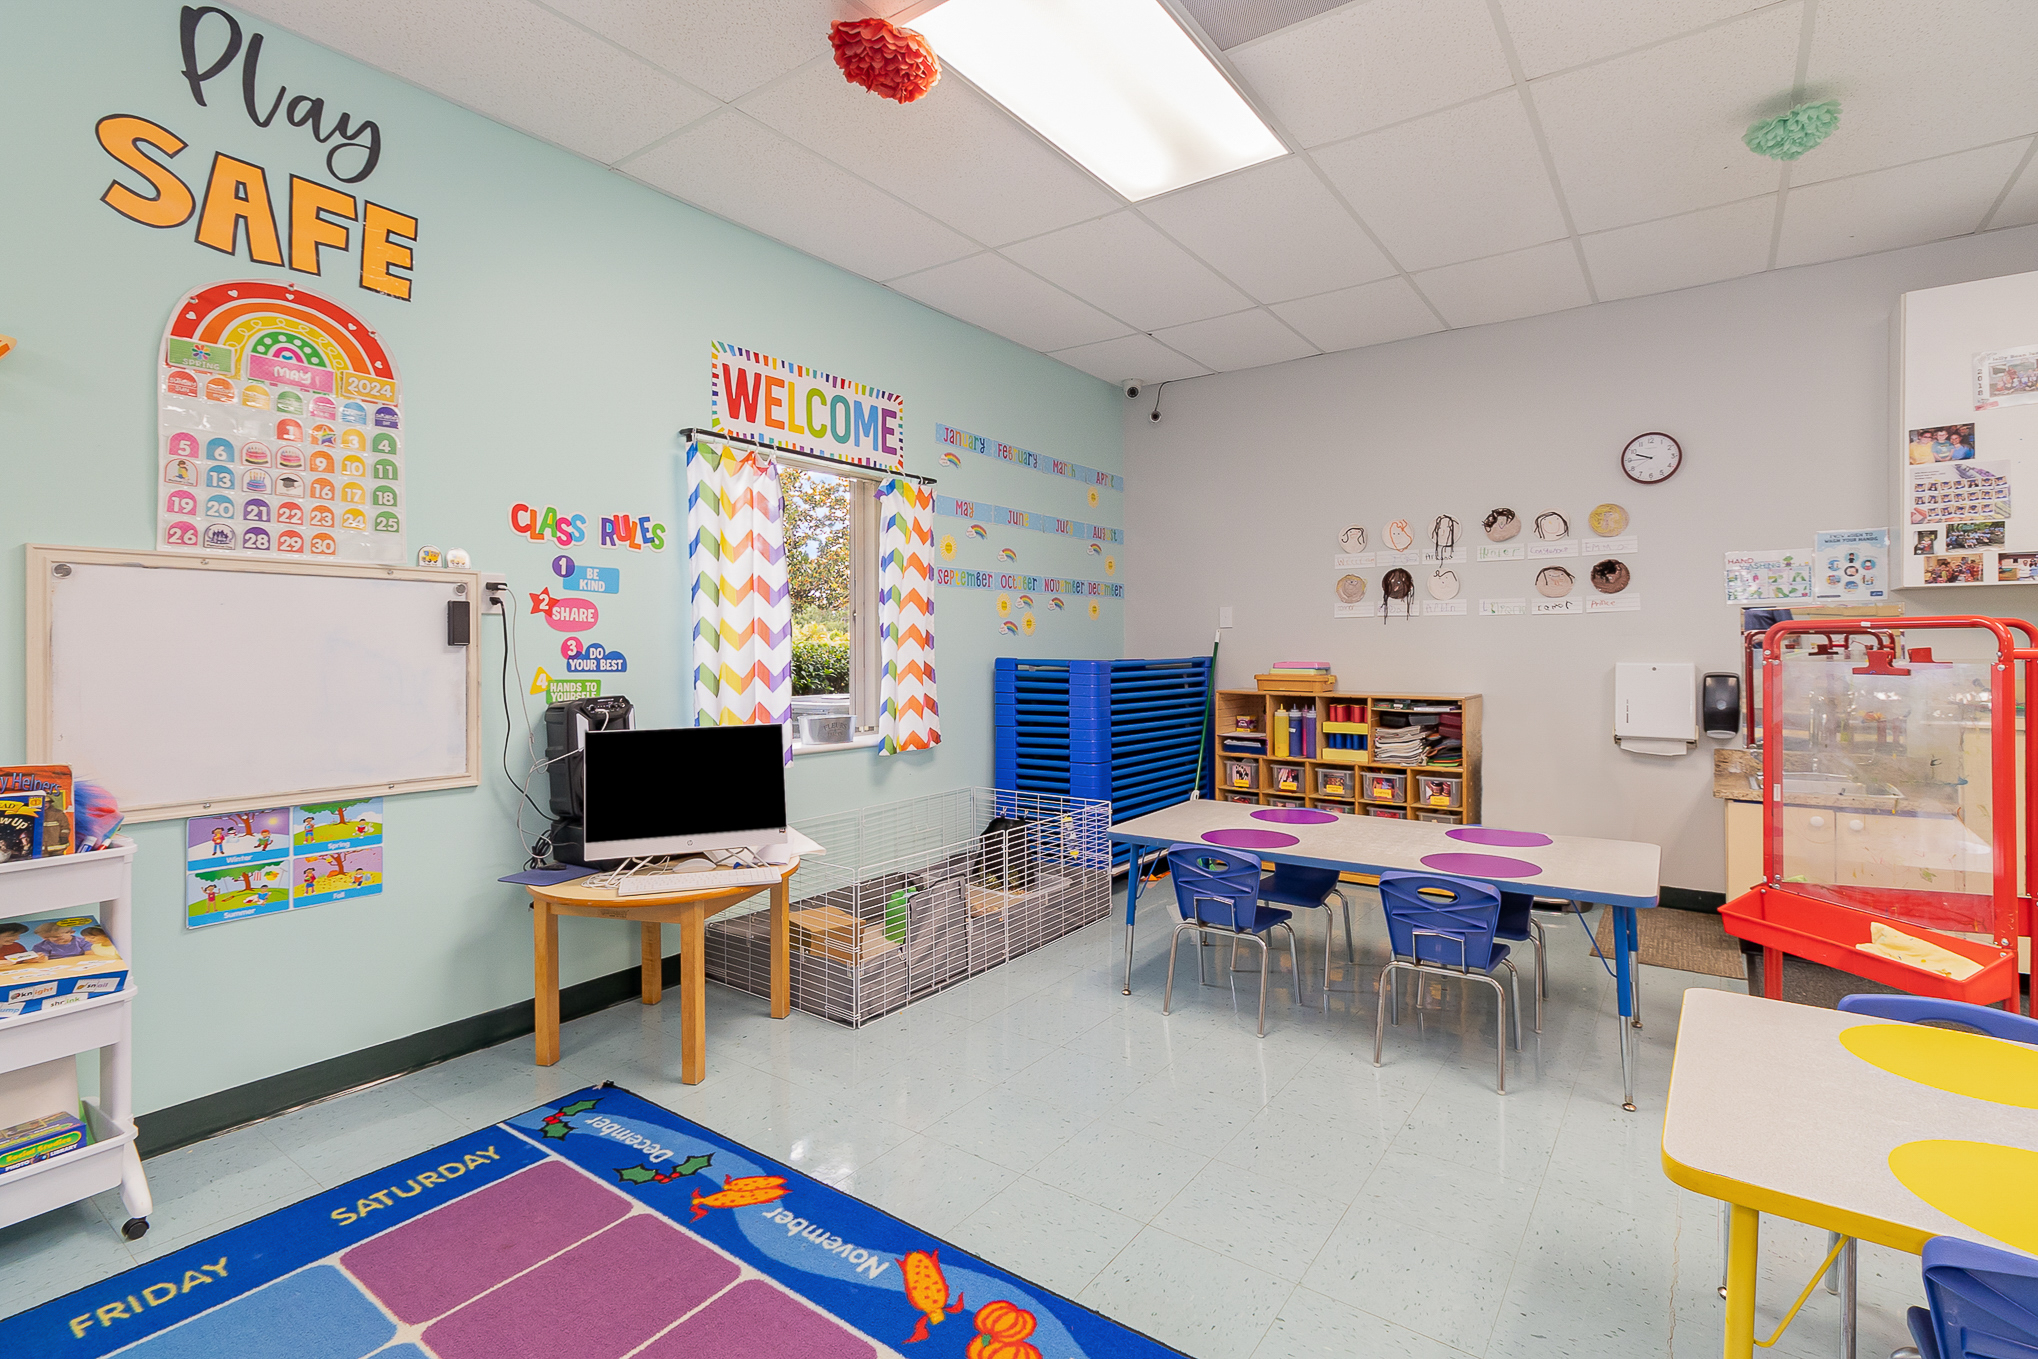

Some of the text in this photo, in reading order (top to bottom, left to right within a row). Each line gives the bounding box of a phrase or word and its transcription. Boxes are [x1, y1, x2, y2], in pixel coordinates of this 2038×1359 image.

[180, 5, 380, 183] Play
[95, 113, 418, 302] SAFE
[182, 358, 220, 371] SPRING
[274, 366, 312, 384] MAY
[348, 376, 393, 398] 2024
[721, 362, 897, 456] WELCOME
[178, 440, 226, 460] 5 6
[348, 436, 359, 448] 3
[378, 439, 392, 453] 4
[943, 427, 986, 454] January
[997, 443, 1038, 469] February
[1052, 459, 1076, 478] March
[317, 457, 394, 477] 9 10 11
[210, 472, 232, 487] 13
[314, 485, 332, 499] 16
[345, 488, 362, 502] 17
[377, 491, 394, 506] 18
[171, 497, 398, 532] 19 20 21 22 23 24 25
[955, 500, 1118, 542] May June July August
[511, 503, 666, 550] CLASS RULES
[168, 526, 335, 554] 26 28 29 30
[558, 557, 566, 576] 1
[1727, 557, 1754, 565] HAND
[586, 568, 600, 580] BE
[937, 569, 1123, 597] September October November December
[579, 579, 606, 592] KIND
[539, 594, 550, 610] 2
[552, 607, 595, 623] SHARE
[567, 640, 577, 656] 3
[589, 647, 604, 659] DO
[569, 659, 624, 671] YOUR BEST
[536, 673, 548, 689] 4
[550, 682, 598, 693] HANDS TO
[11, 817, 29, 830] Up
[327, 840, 351, 851] Spring
[226, 854, 254, 864] Winter
[332, 891, 345, 900] Fall
[223, 907, 256, 919] Summer
[20, 986, 54, 998] knight
[50, 997, 80, 1008] shrink
[584, 1116, 675, 1163] December
[4, 1143, 78, 1172] PHOTO LIBRARY
[331, 1145, 501, 1225] SATURDAY
[761, 1207, 890, 1280] November
[68, 1256, 229, 1339] FRIDAY
